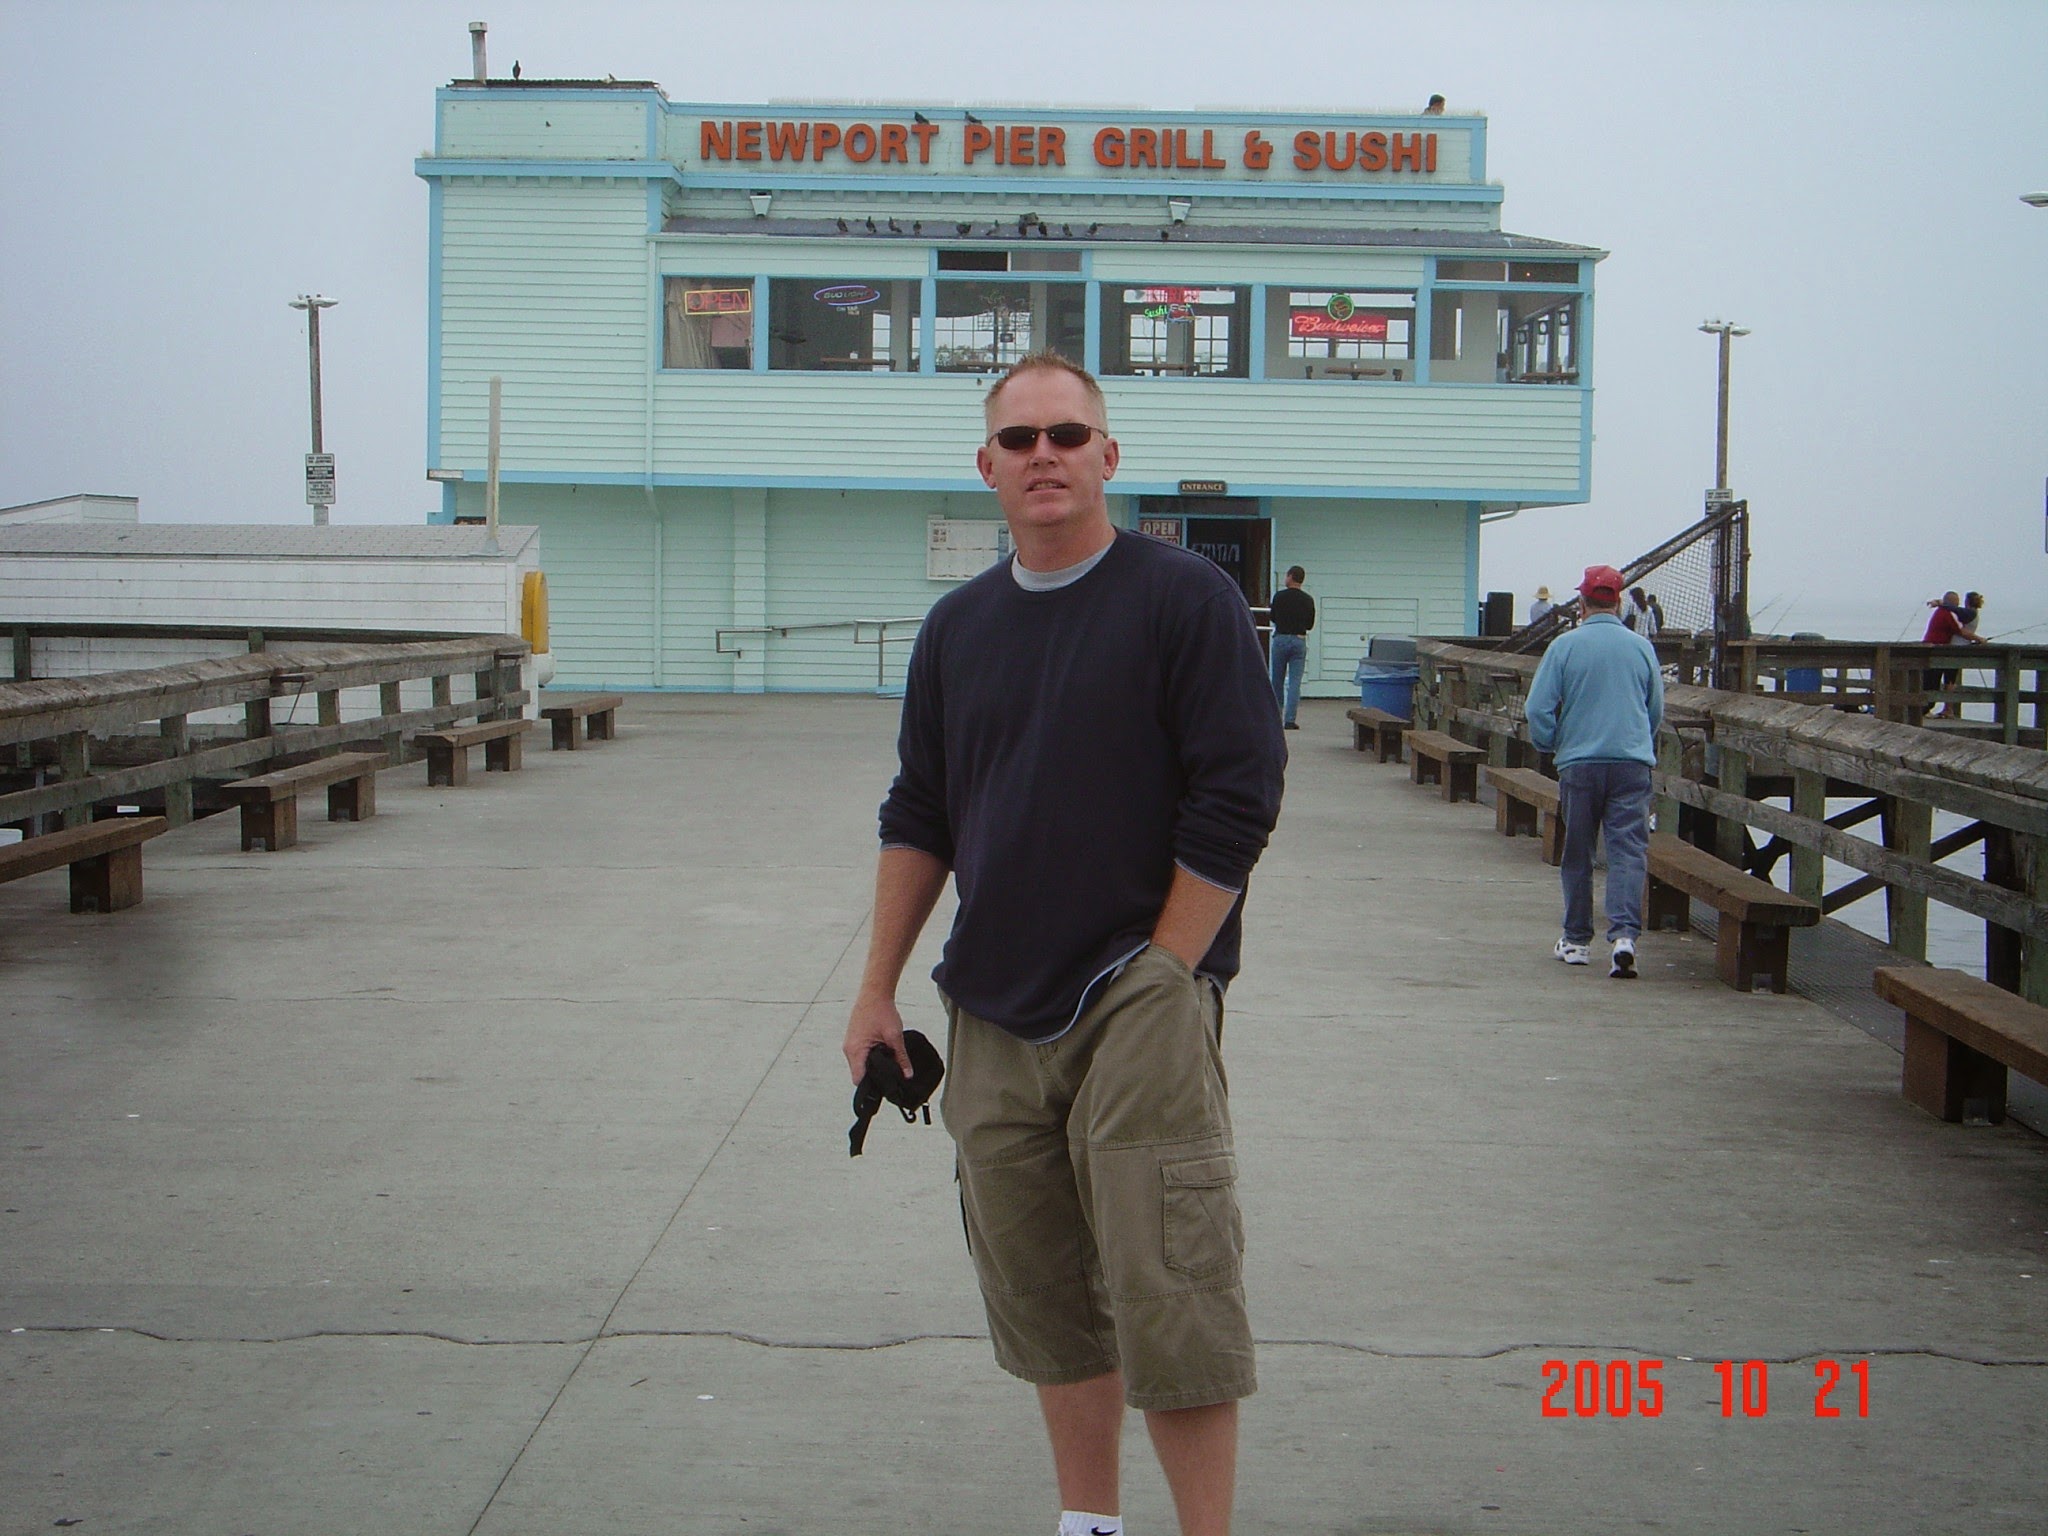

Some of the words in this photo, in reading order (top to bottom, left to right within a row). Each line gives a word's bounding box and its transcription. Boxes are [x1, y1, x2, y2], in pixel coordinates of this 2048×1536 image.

[700, 121, 940, 164] NEWPORT
[963, 125, 1066, 166] PIER
[1093, 127, 1227, 169] GRILL
[1243, 130, 1274, 170] &
[1293, 131, 1437, 173] SUSHI
[687, 292, 748, 311] OPEN
[1294, 315, 1386, 334] Budweiser
[1181, 483, 1223, 491] ENTRANCE
[1144, 521, 1176, 536] OPEN
